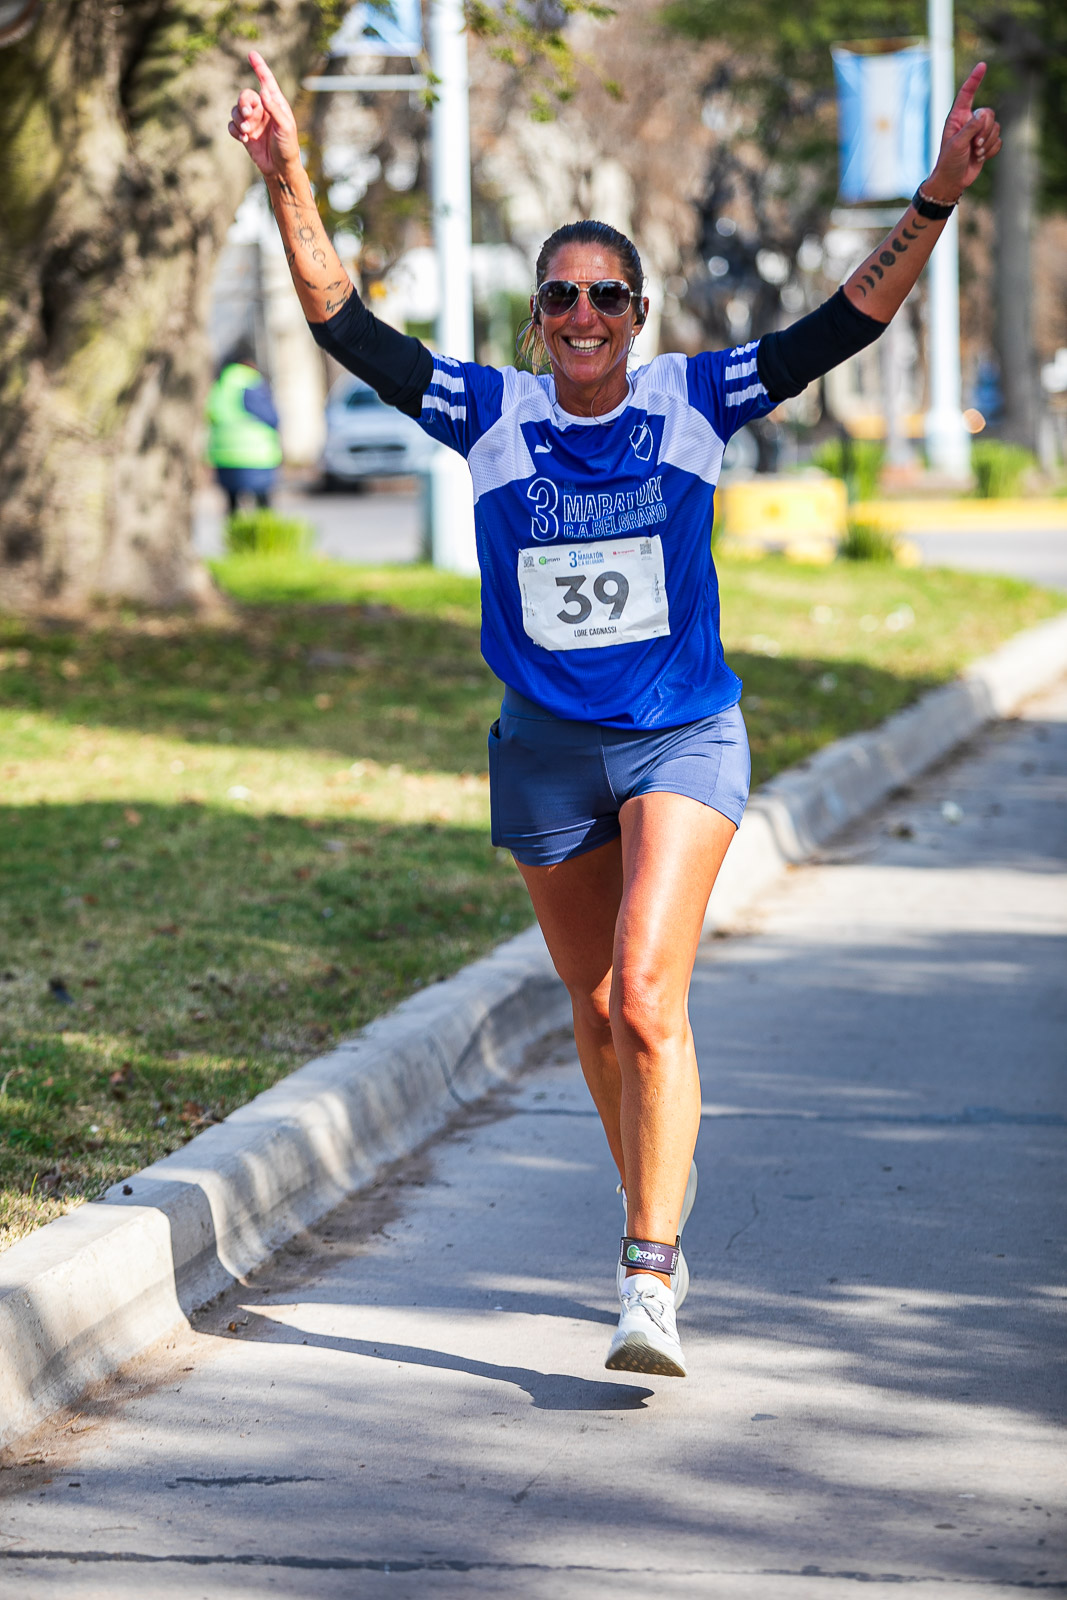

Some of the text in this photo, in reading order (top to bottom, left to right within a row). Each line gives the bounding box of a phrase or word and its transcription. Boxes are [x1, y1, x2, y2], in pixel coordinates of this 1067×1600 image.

[527, 477, 559, 541] 3
[568, 550, 578, 568] 3
[555, 571, 630, 625] 39
[573, 626, 617, 638] LORE CAGNASSI
